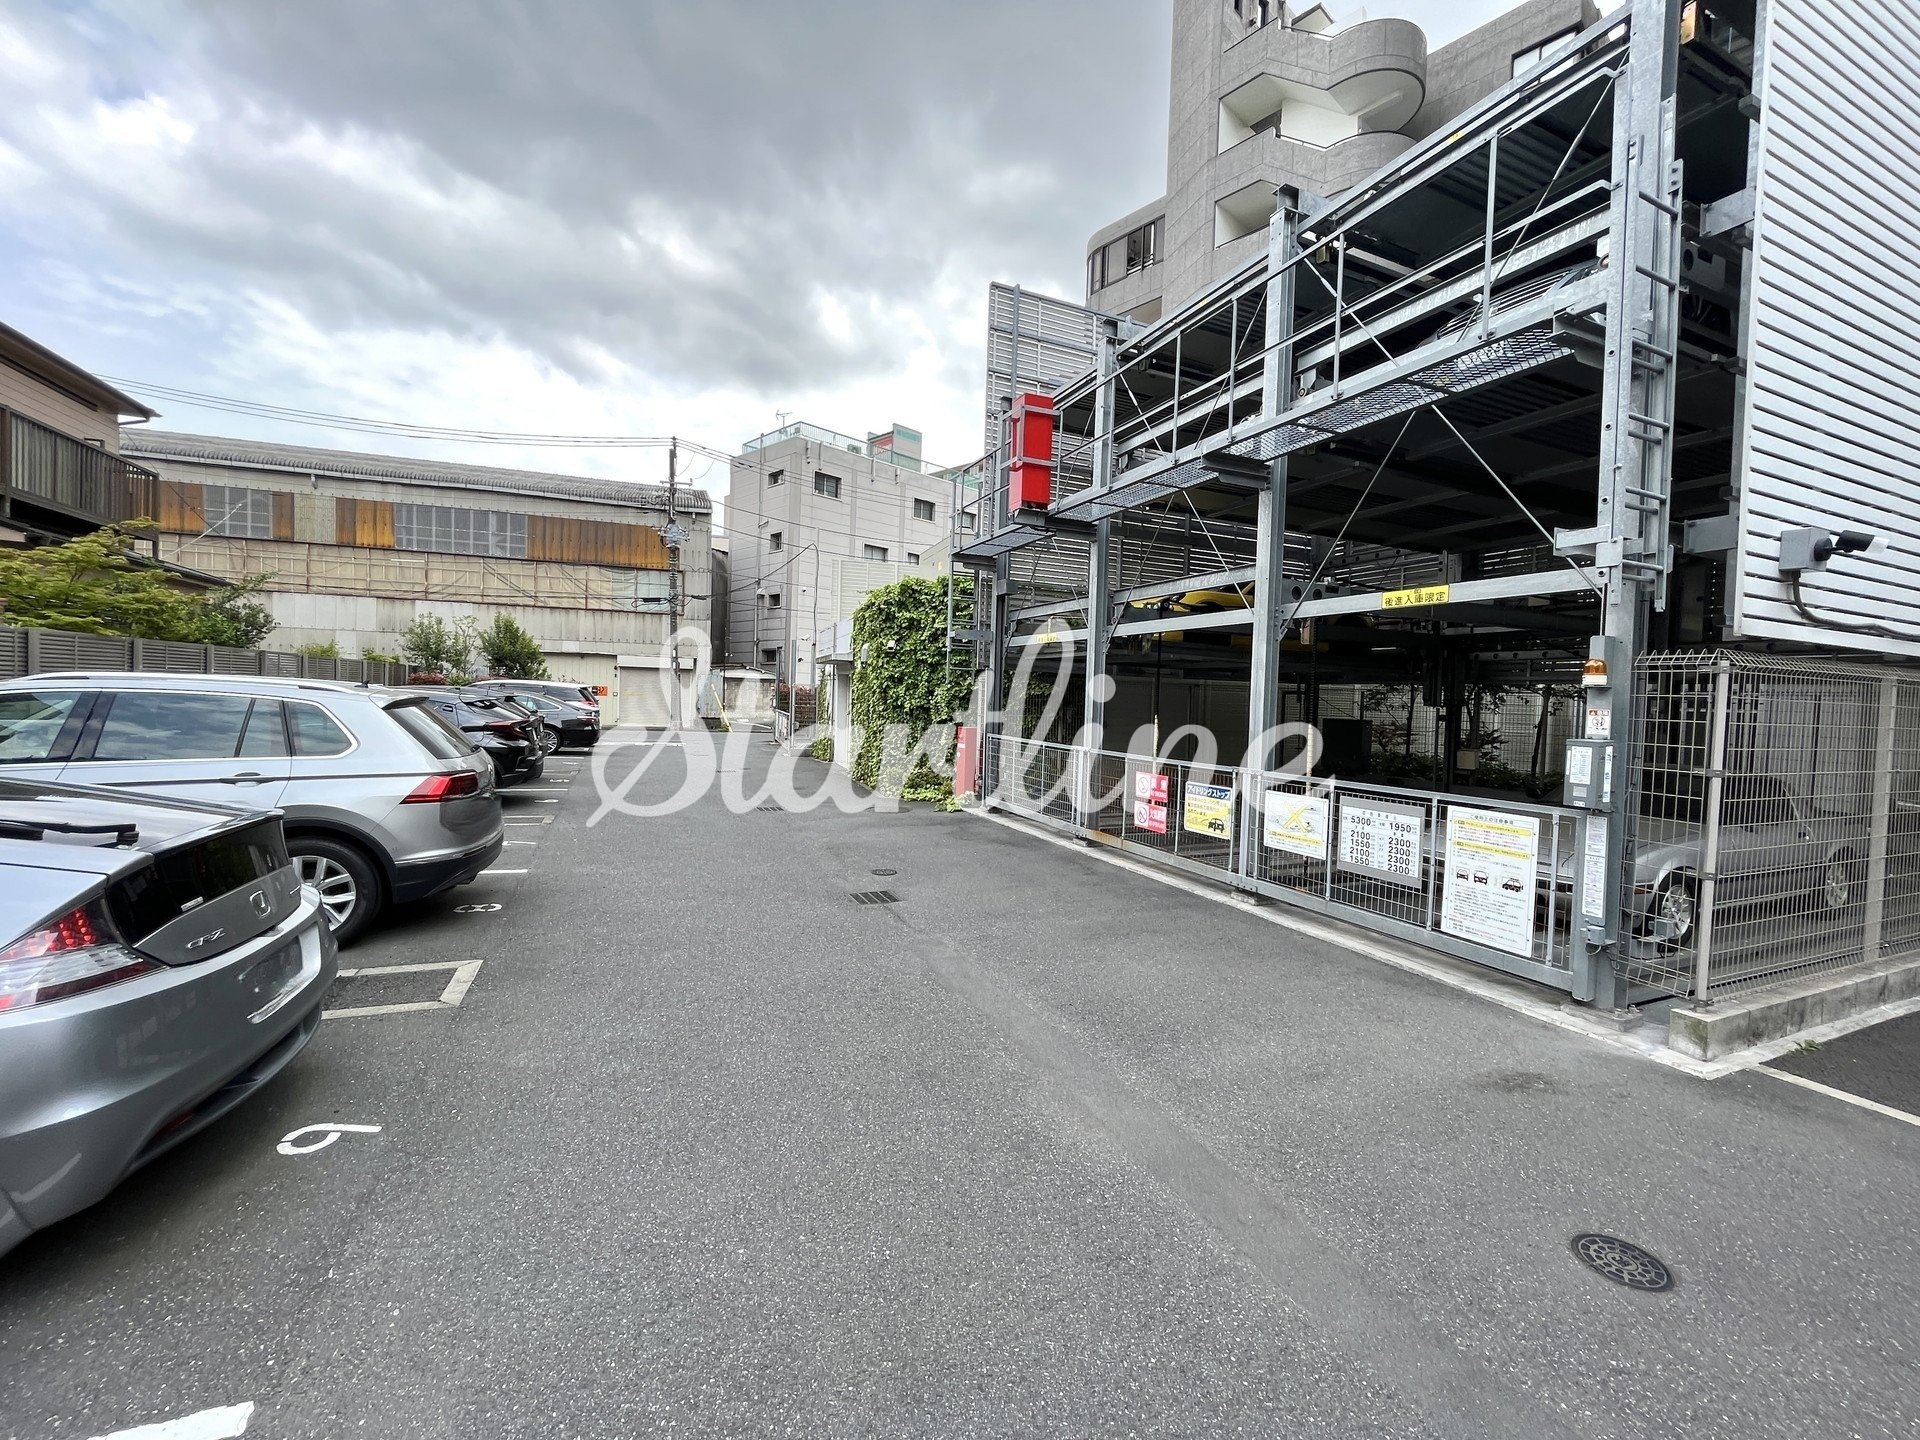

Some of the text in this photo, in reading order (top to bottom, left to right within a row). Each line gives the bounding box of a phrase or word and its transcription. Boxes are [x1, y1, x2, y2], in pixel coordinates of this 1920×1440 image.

[1384, 591, 1446, 607] 後進入庫限定
[1187, 785, 1230, 800] アイドリングストップ
[1351, 815, 1371, 826] 5300
[1389, 822, 1412, 833] 1950
[1350, 830, 1371, 841] 2100
[1350, 838, 1371, 849] 1550
[1388, 836, 1411, 848] 2300
[1349, 847, 1370, 858] 2100
[1388, 845, 1411, 857] 2300
[1349, 855, 1370, 866] 1550
[1387, 854, 1410, 866] 2300
[1387, 863, 1410, 875] 2300
